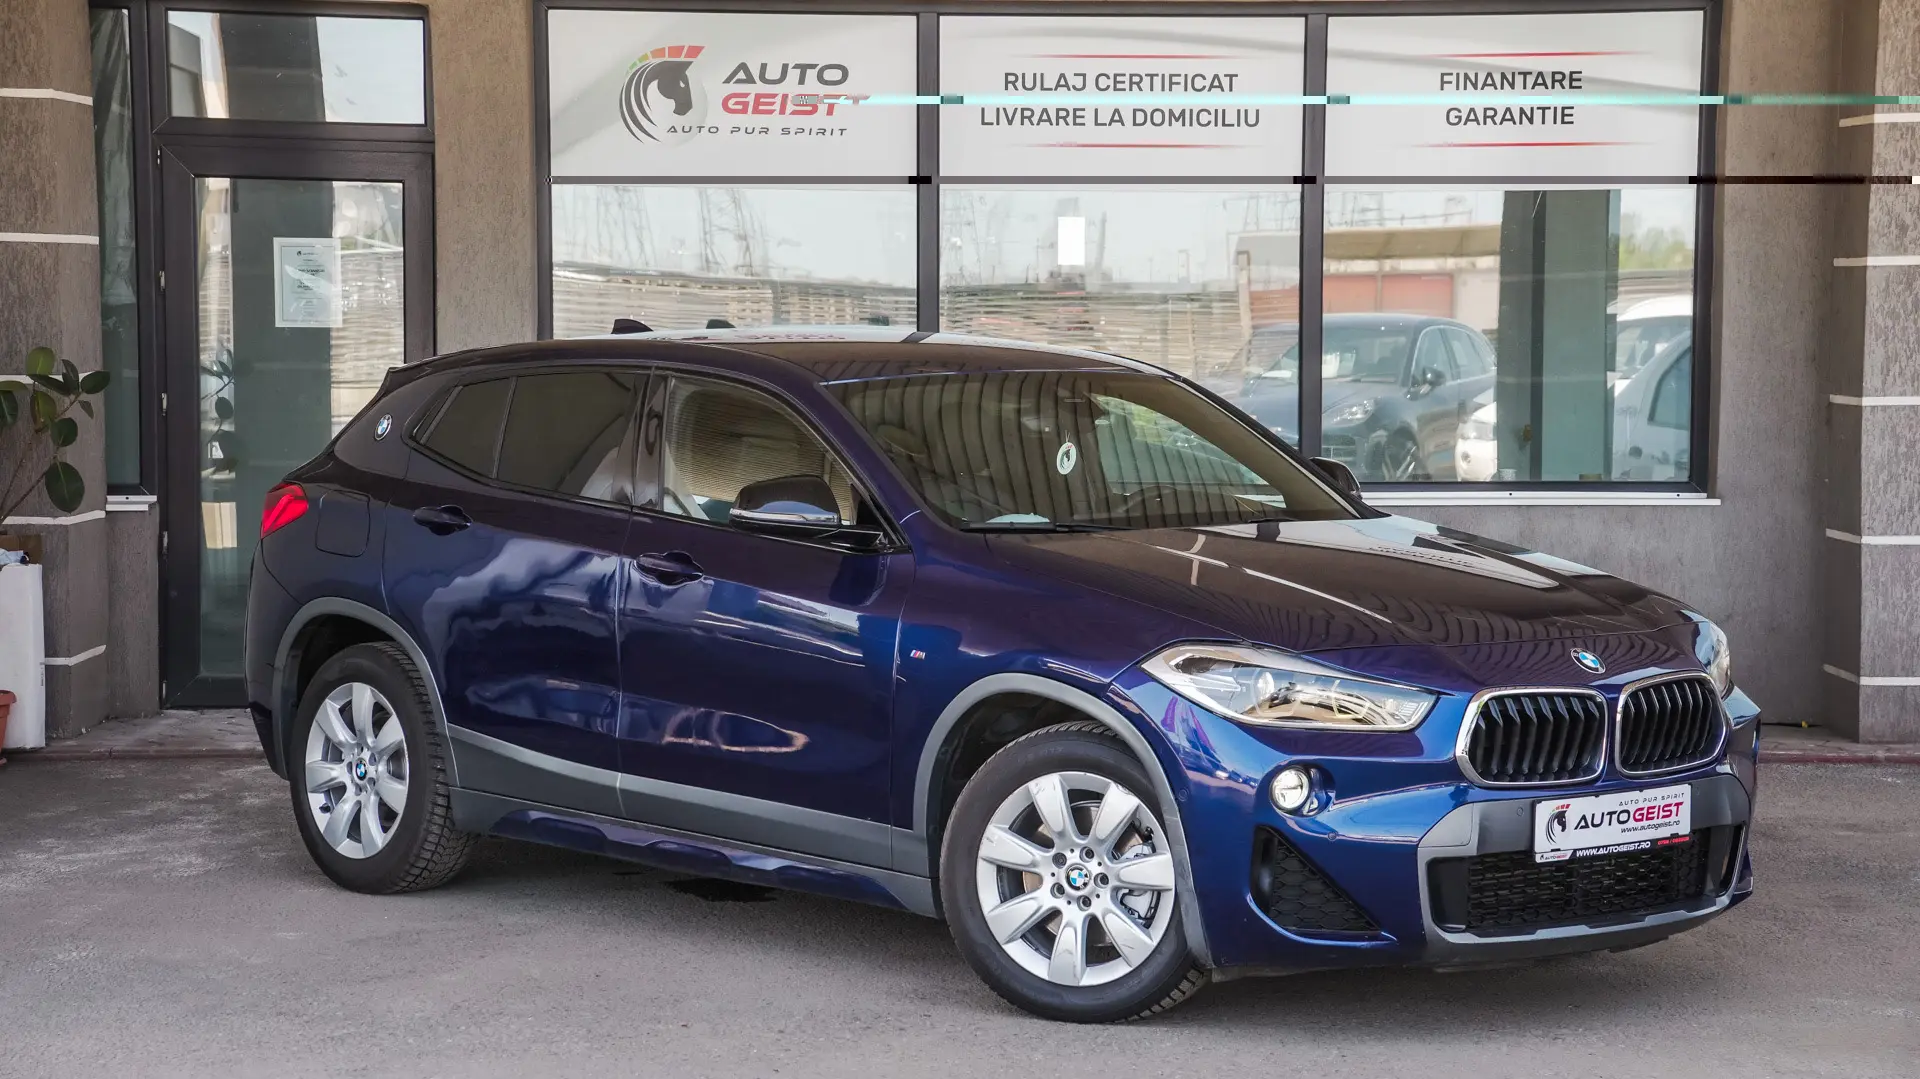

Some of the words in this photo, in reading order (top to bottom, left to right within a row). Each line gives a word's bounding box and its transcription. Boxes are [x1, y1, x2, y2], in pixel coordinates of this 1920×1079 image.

[722, 62, 849, 86] AUTO
[1004, 72, 1087, 92] RULAJ
[1095, 72, 1238, 93] CERTIFICAT
[1440, 71, 1583, 91] FINANTARE
[980, 107, 1086, 126] LIVRARE
[1094, 108, 1125, 127] LA
[1132, 108, 1260, 128] DOMICILIU
[1445, 106, 1575, 126] GARANTIE
[666, 125, 719, 134] AUTO
[730, 126, 769, 135] PUR
[780, 127, 847, 136] SPIRIT
[1618, 799, 1639, 807] AUTO
[1642, 796, 1658, 805] PUR
[1661, 792, 1685, 801] SPIRIT
[1573, 802, 1684, 831] AUTOGEIST
[1620, 819, 1680, 834] www.autogeist.ro
[1576, 841, 1651, 857] WWW.AUTOGEIST.RO
